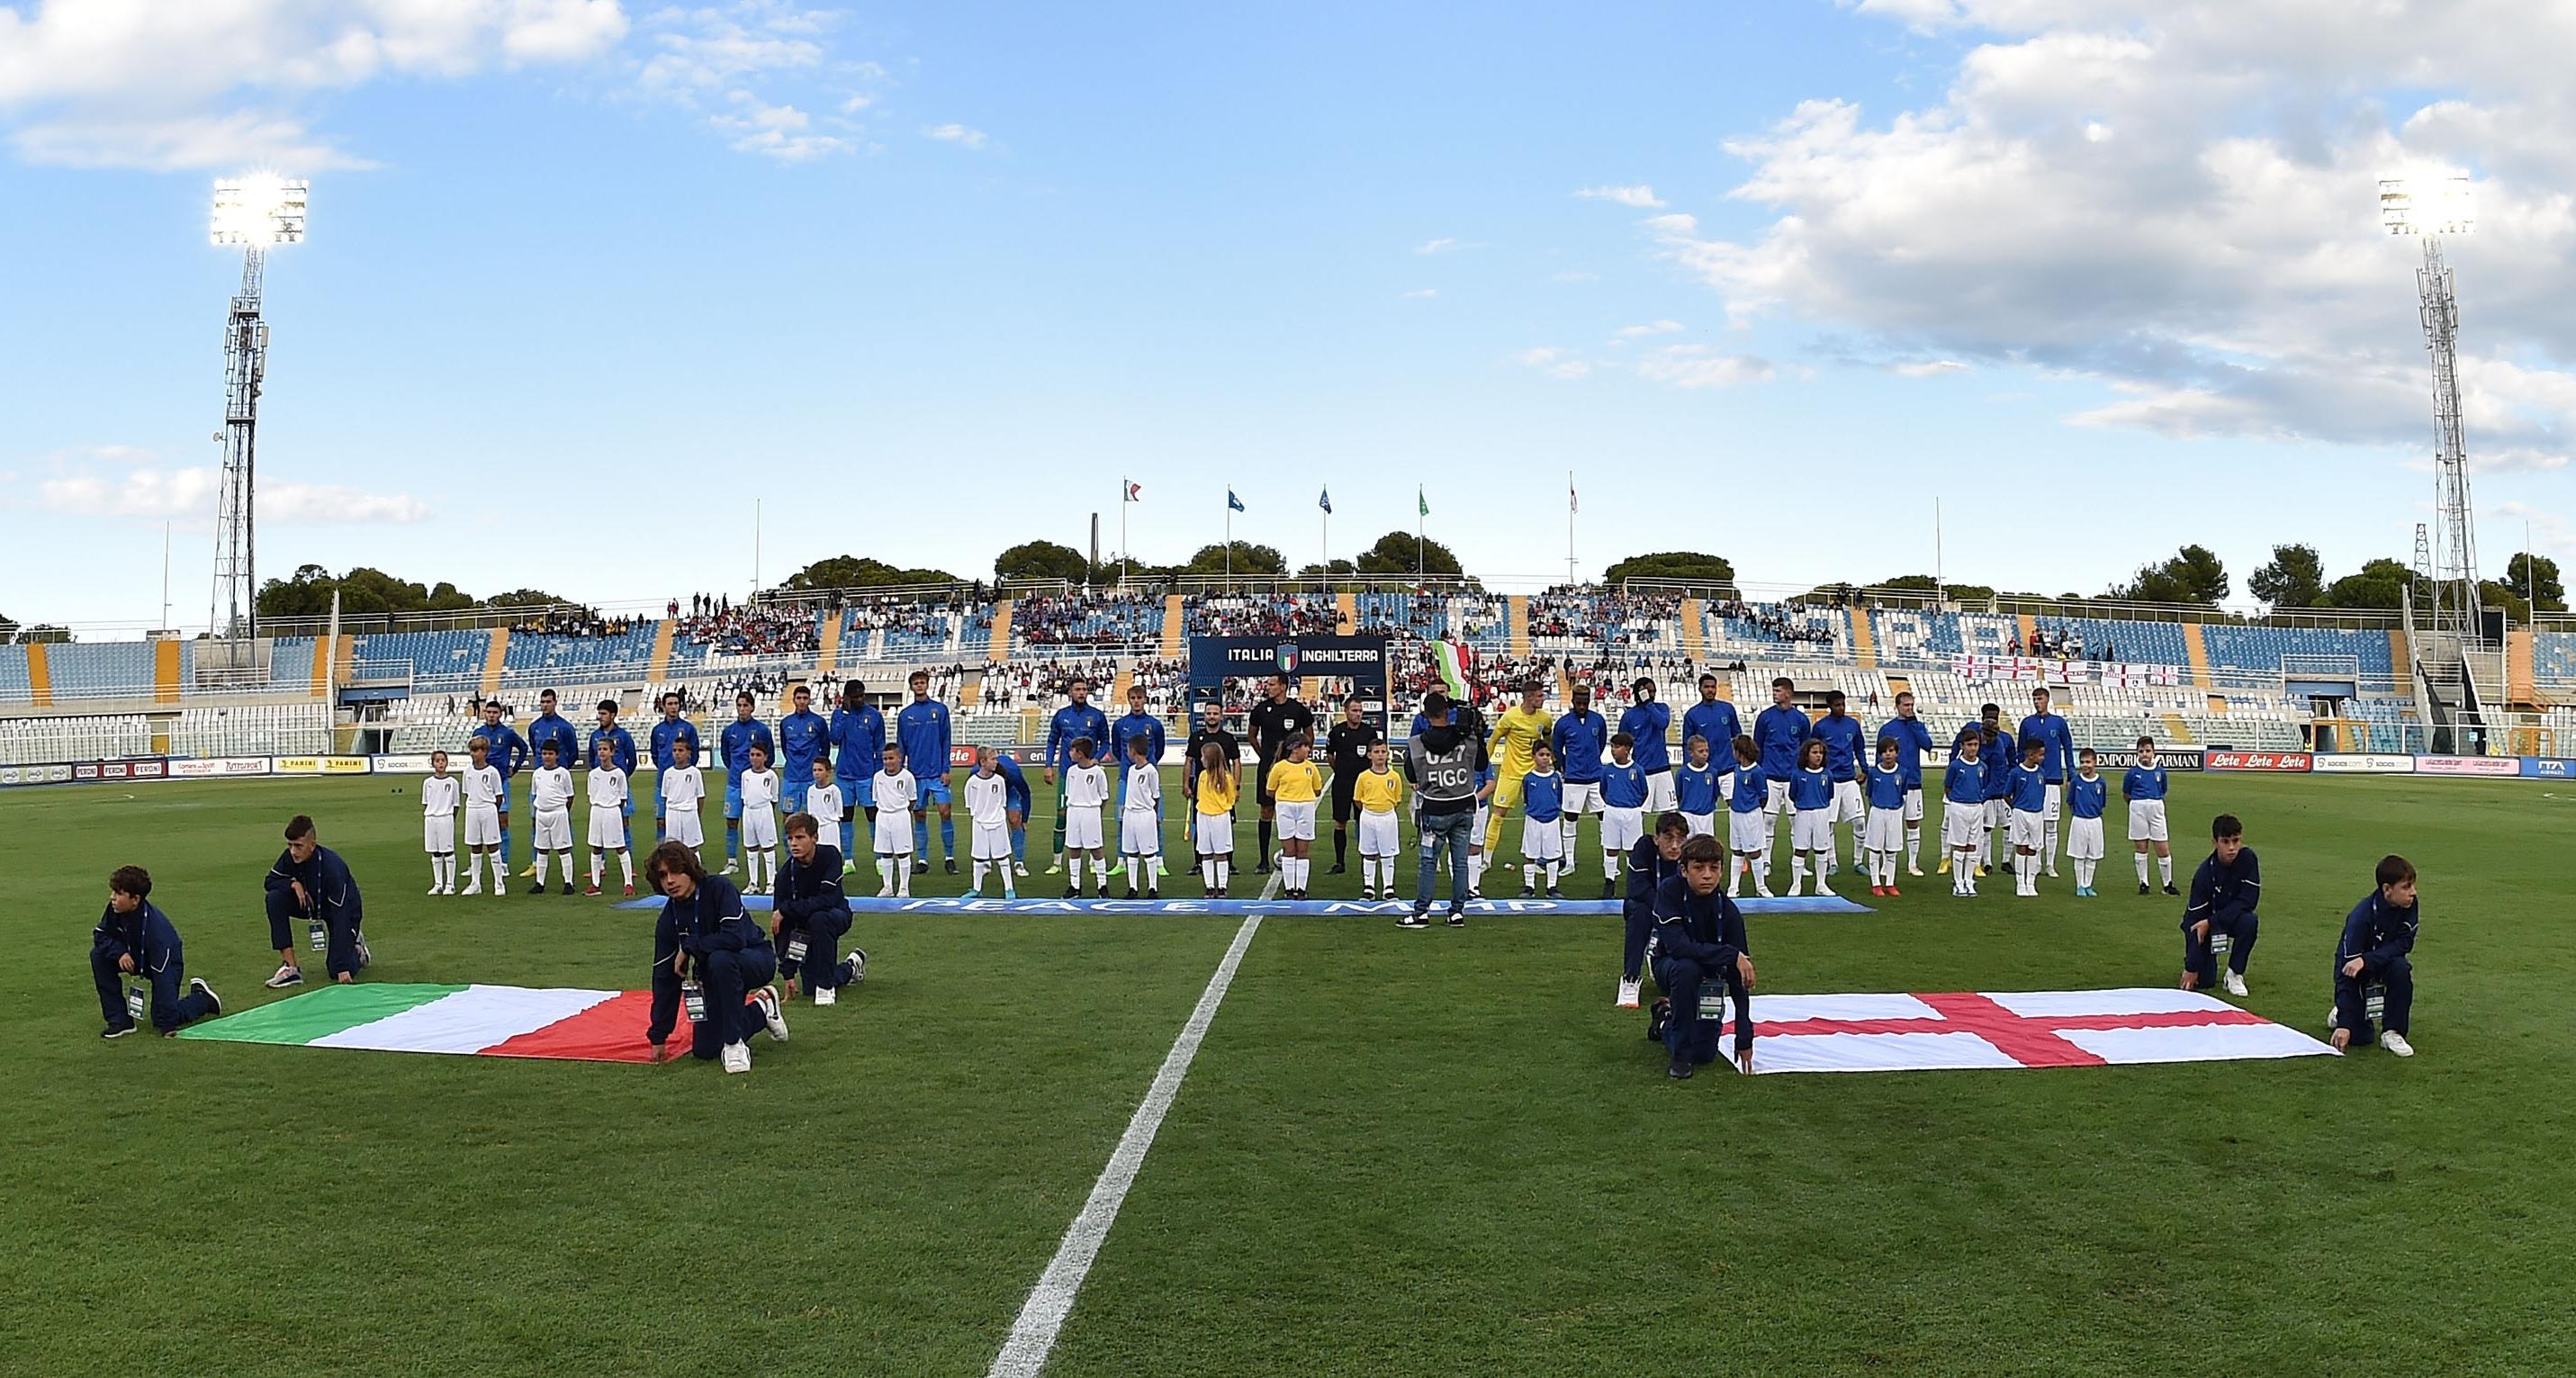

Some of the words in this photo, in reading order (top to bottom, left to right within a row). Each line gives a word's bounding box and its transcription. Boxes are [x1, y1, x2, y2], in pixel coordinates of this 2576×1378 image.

[1229, 649, 1274, 661] ITALIA
[1302, 650, 1379, 662] INGHILTERRA
[950, 749, 969, 761] ete
[1030, 749, 1046, 761] eni
[2160, 754, 2199, 766] ARMANI
[2211, 753, 2239, 767] Lete
[2244, 754, 2273, 767] Lete
[2276, 755, 2306, 768] Lete
[2538, 761, 2565, 770] ITA
[1428, 768, 1468, 787] FIGC
[1855, 797, 1860, 809] 7
[901, 900, 1209, 912] PEACE
